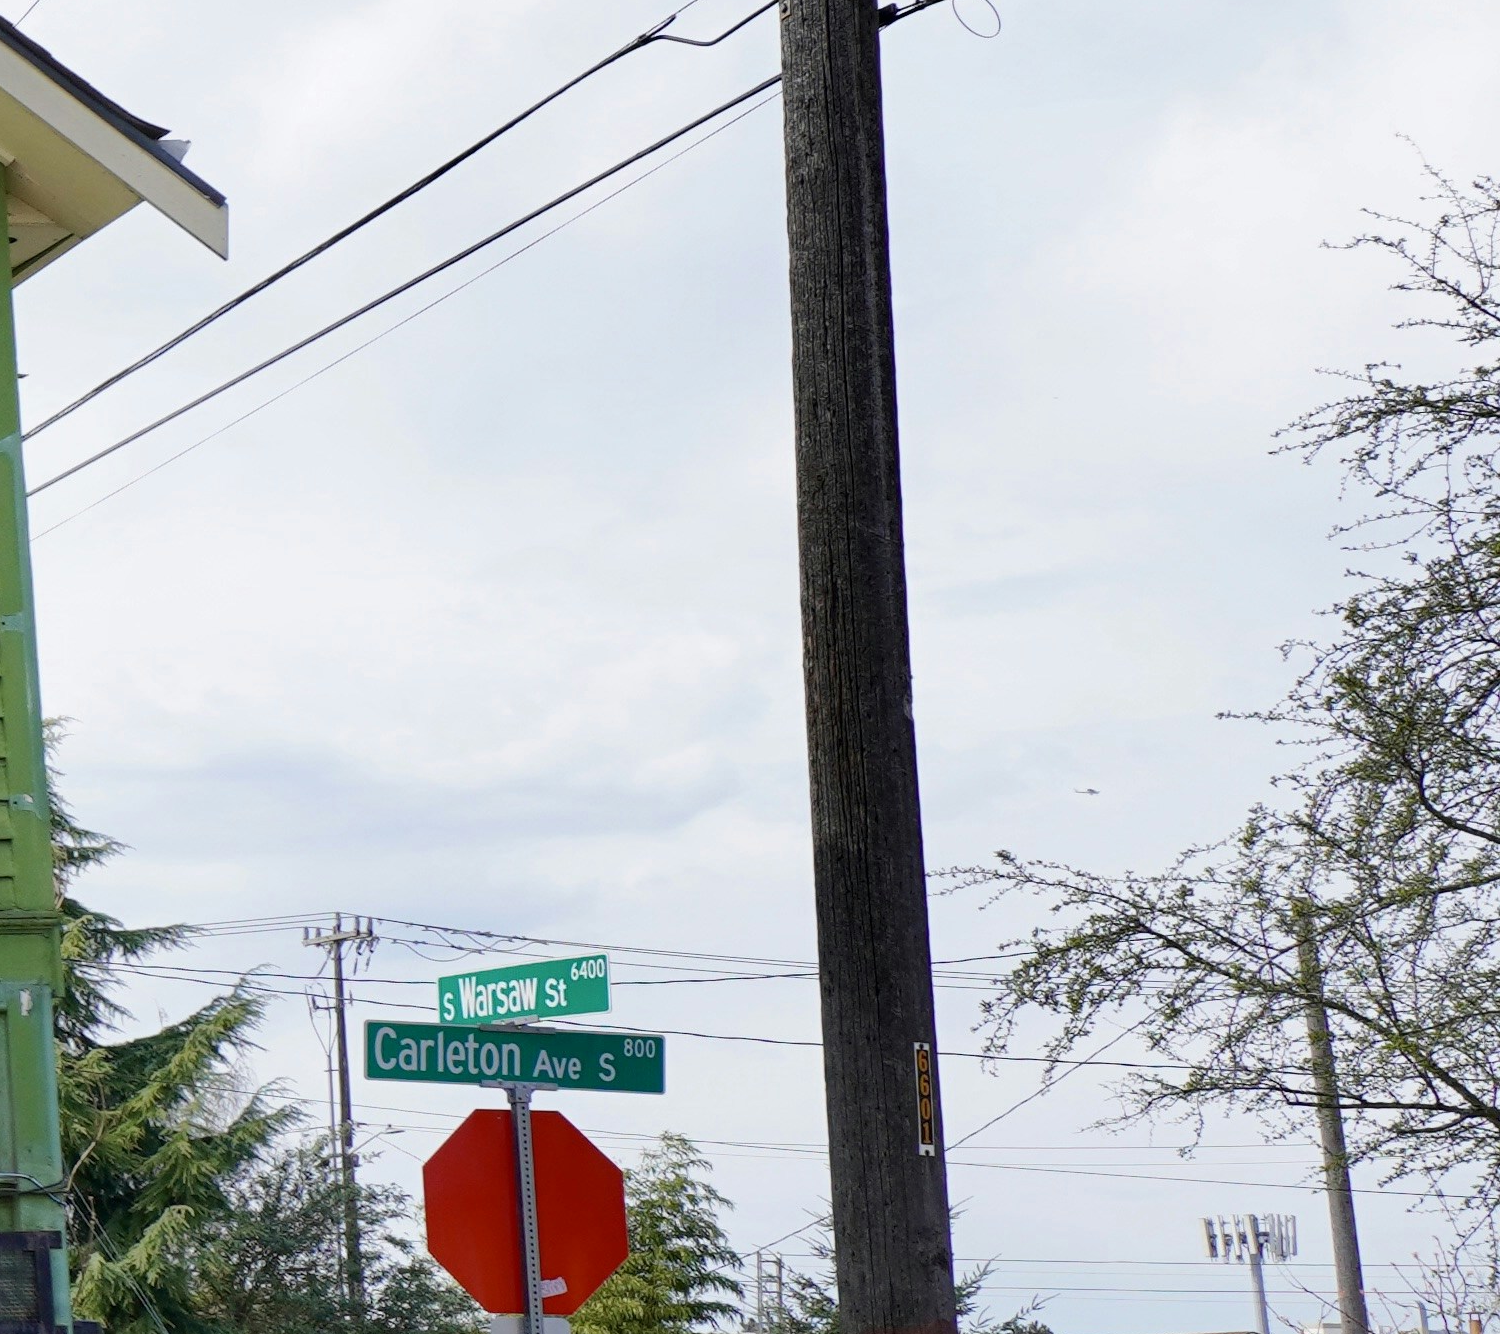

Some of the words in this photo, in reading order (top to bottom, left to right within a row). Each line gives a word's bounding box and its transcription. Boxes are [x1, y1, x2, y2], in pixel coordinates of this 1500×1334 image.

[443, 992, 455, 1021] S
[458, 976, 538, 1019] Warsaw
[544, 978, 568, 1008] St
[570, 958, 606, 981] 6400
[374, 1027, 521, 1077] Carleton
[532, 1049, 582, 1080] Ave
[598, 1053, 616, 1082] S
[623, 1039, 656, 1059] 800
